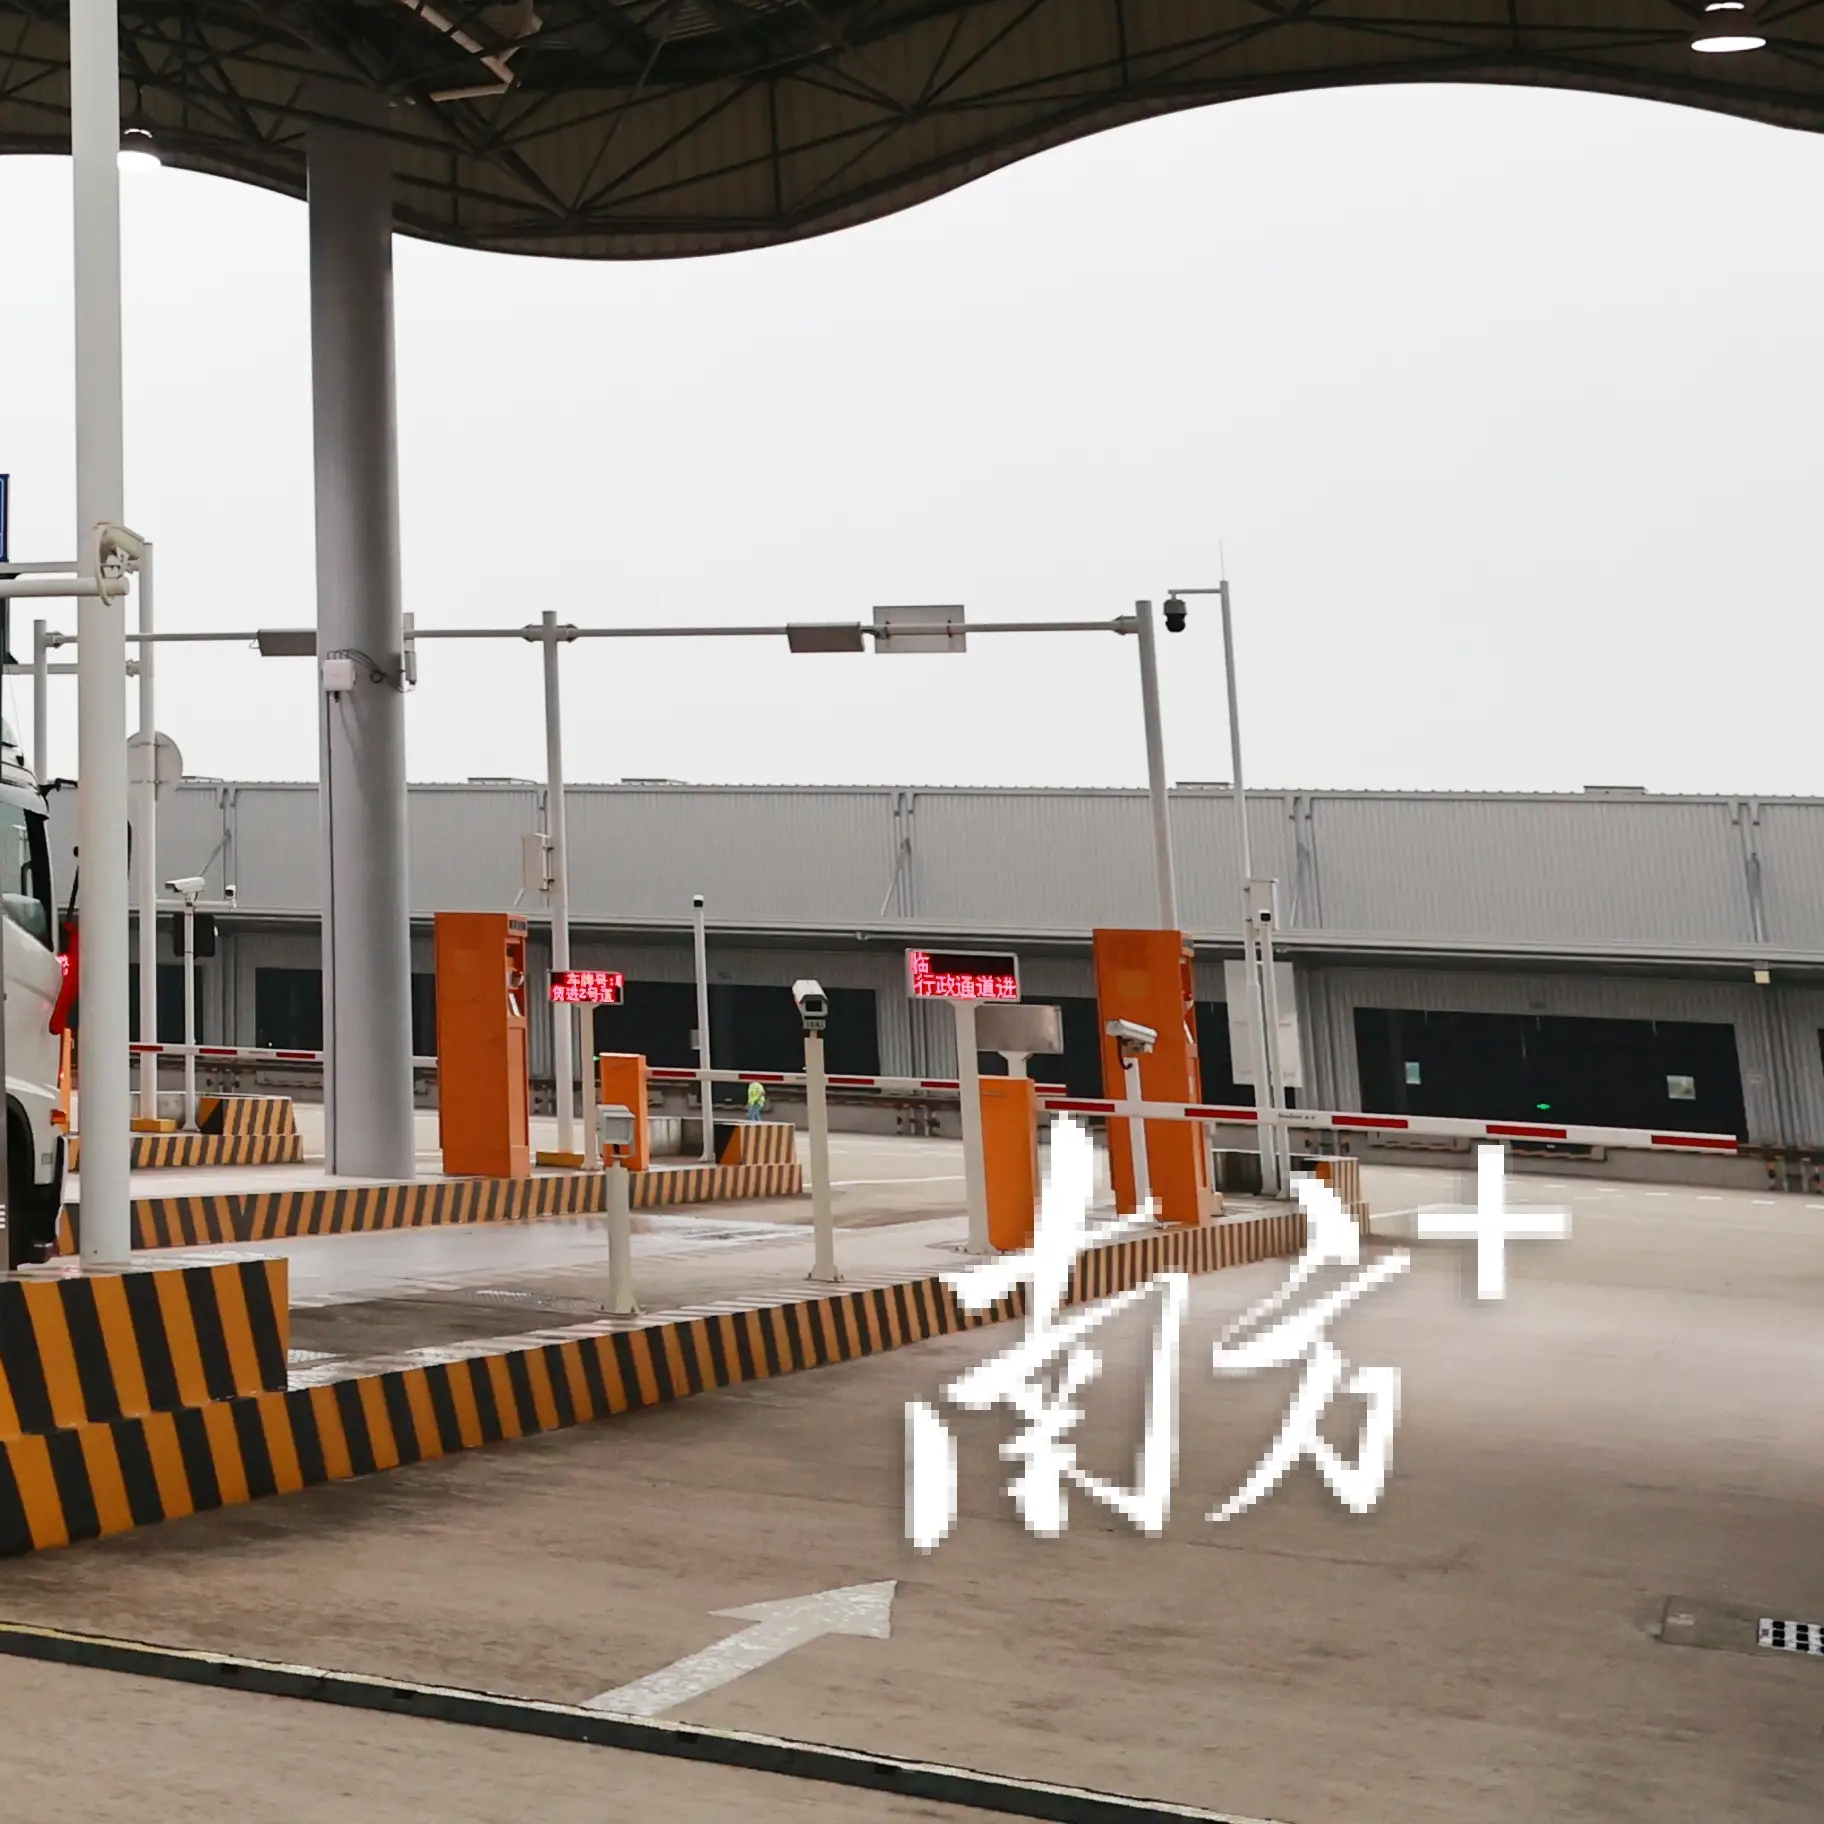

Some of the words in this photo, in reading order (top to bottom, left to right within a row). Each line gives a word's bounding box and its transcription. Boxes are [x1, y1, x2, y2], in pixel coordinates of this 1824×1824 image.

[912, 973, 1017, 998] 行政通道进
